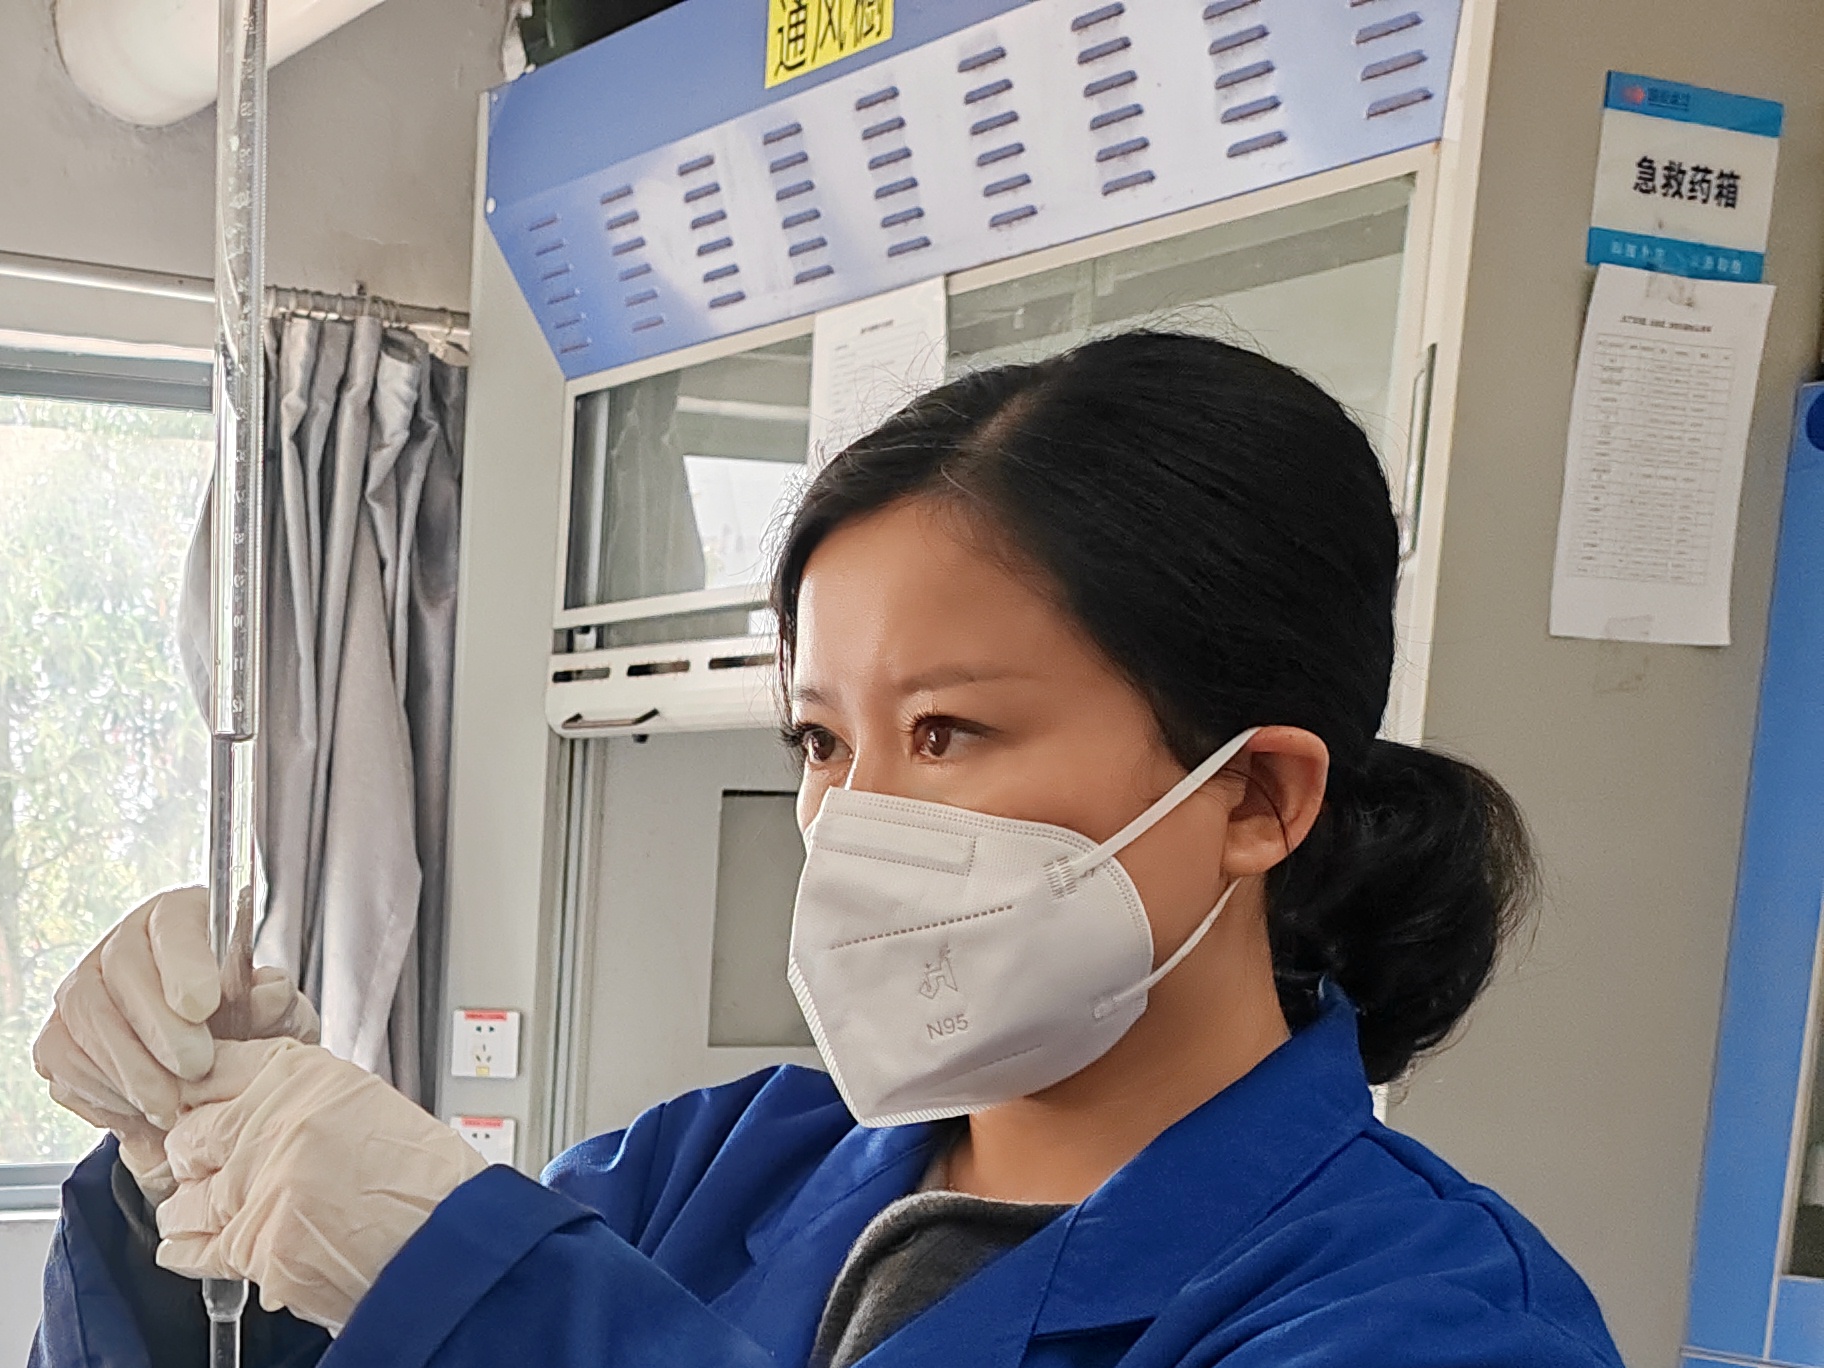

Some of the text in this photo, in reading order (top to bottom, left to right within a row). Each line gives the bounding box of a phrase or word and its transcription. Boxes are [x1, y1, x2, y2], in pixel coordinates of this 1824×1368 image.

[1633, 155, 1742, 210] 急救药箱
[926, 1013, 969, 1040] N95
